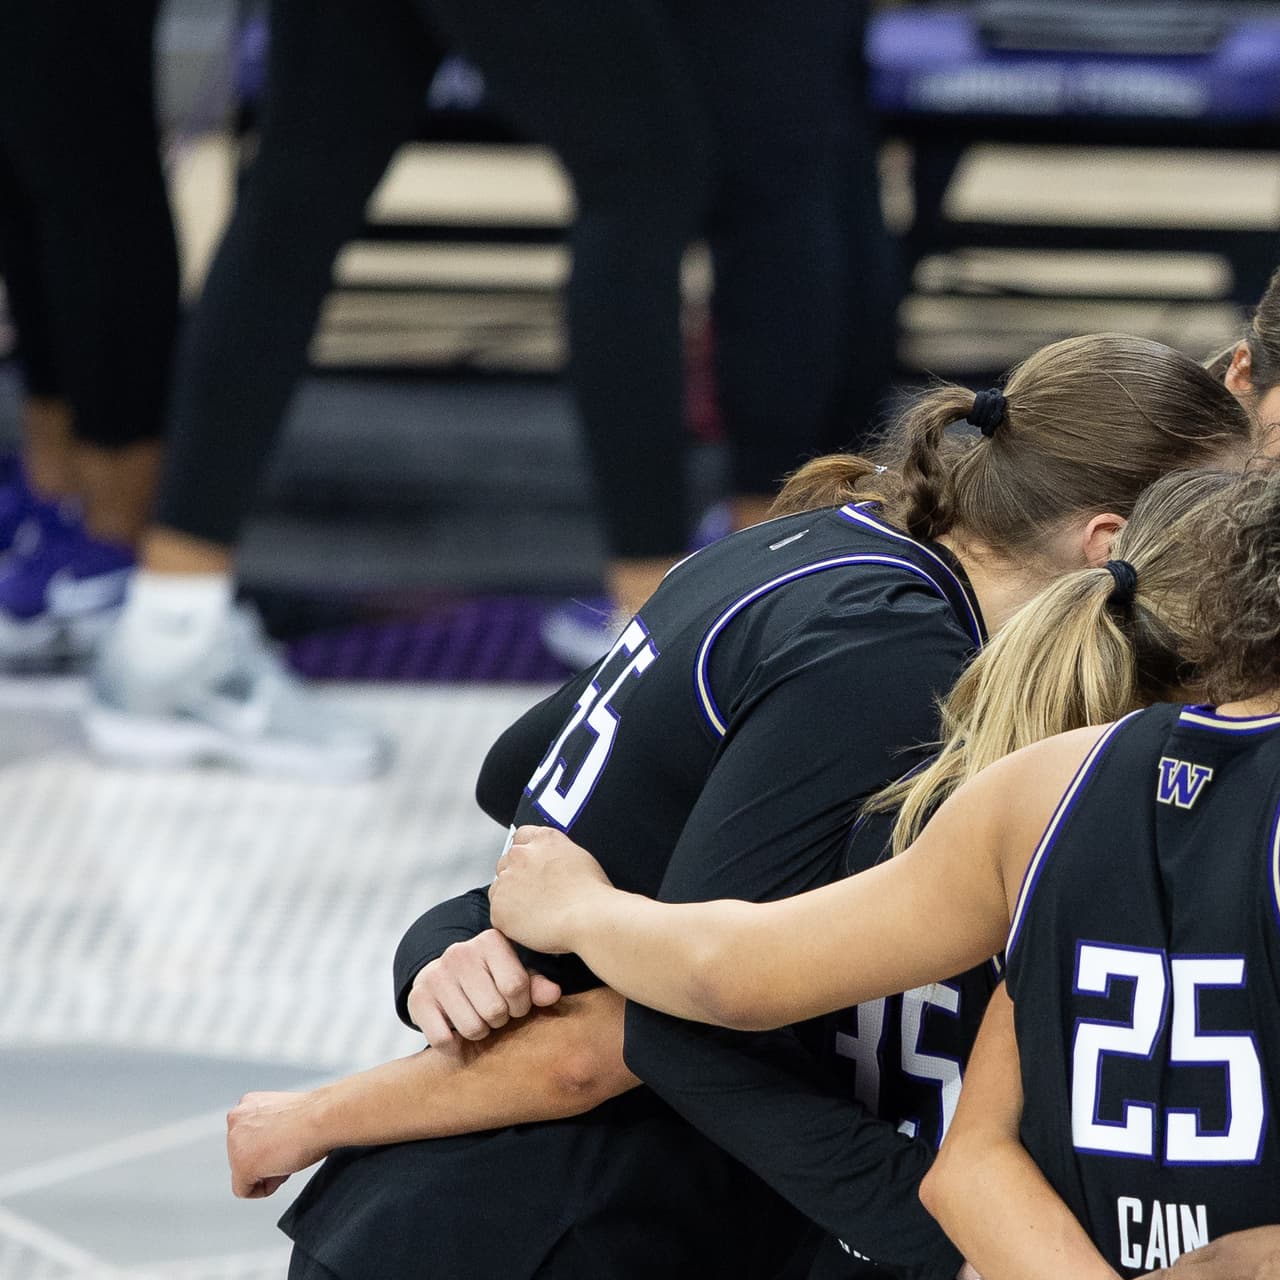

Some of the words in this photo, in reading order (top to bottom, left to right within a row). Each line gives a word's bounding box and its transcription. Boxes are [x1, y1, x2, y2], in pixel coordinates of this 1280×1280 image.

[1157, 756, 1214, 810] W
[1072, 938, 1267, 1167] 25
[1117, 1195, 1209, 1271] CAIN
